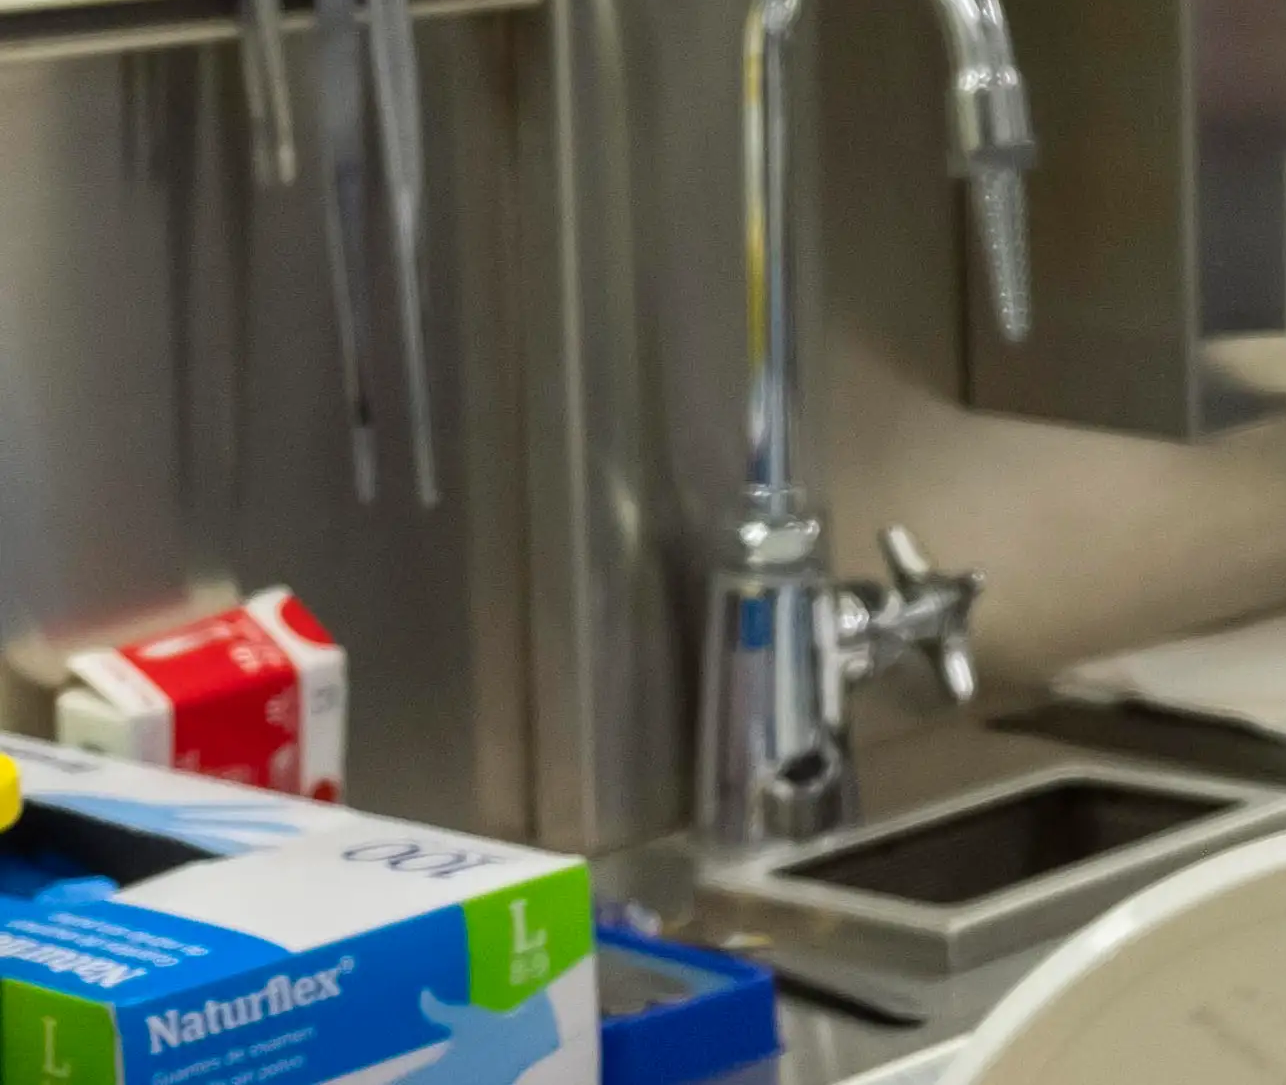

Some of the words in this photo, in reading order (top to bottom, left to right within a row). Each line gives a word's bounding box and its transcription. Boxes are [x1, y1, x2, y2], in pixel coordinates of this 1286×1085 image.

[341, 840, 508, 879] 100
[509, 899, 548, 953] L
[42, 1015, 71, 1078] L
